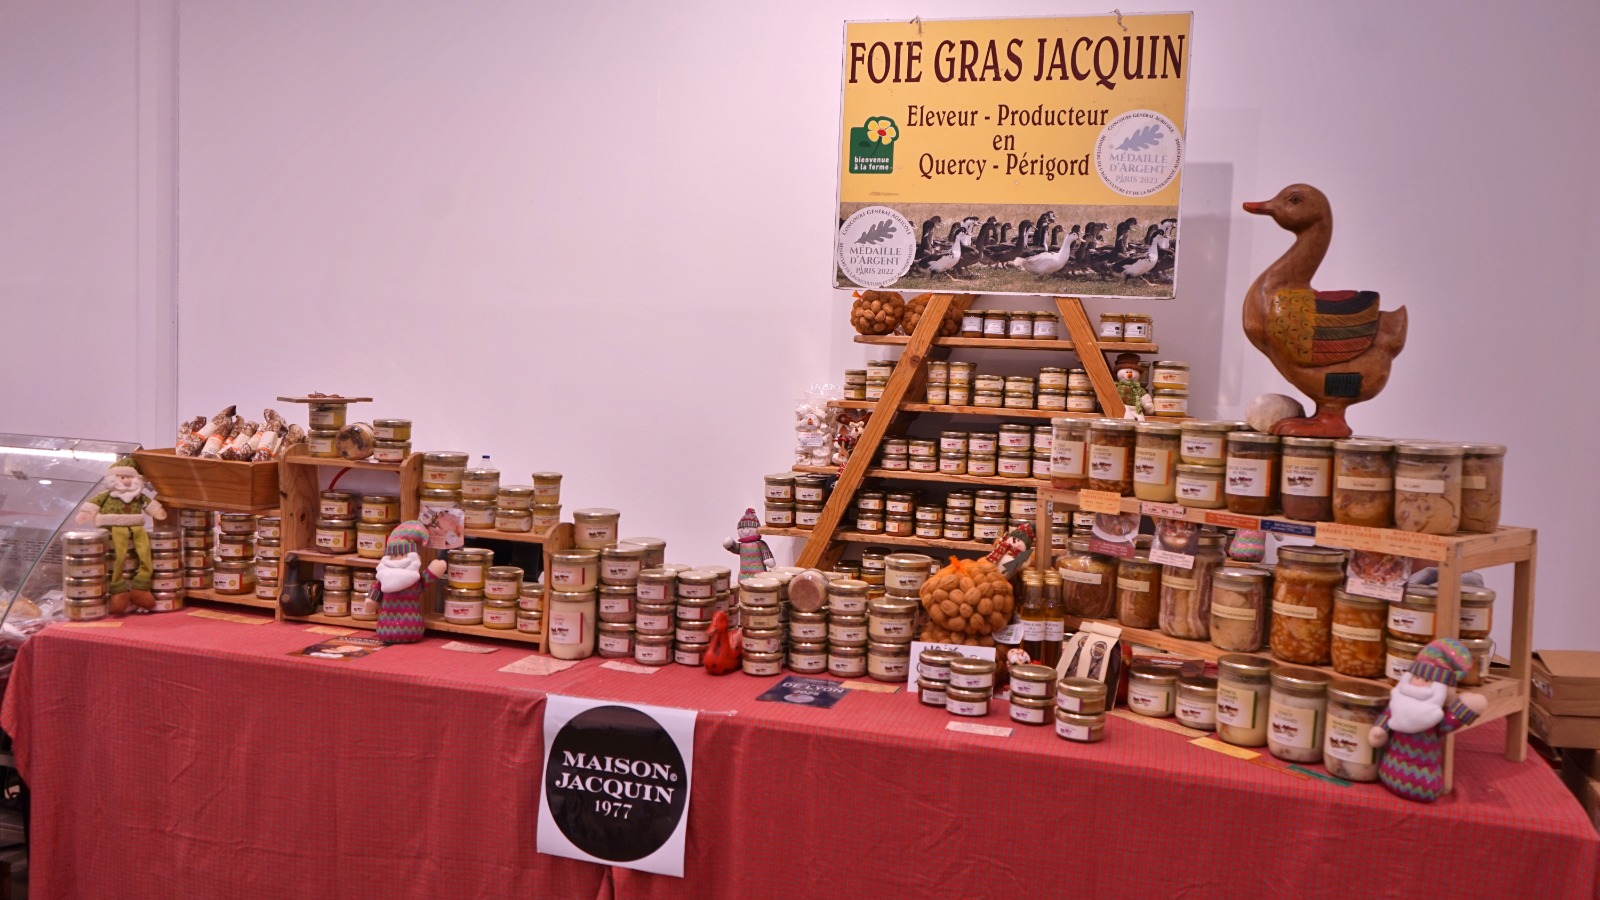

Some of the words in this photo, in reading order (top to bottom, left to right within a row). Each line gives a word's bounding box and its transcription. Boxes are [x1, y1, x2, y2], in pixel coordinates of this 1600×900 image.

[849, 41, 922, 83] FOIE
[934, 38, 1024, 83] GRAS
[1034, 34, 1186, 90] JACQUIN
[907, 105, 978, 127] Eleveur
[997, 104, 1109, 126] Producteur
[993, 133, 1015, 151] en
[1109, 151, 1168, 164] MÉDAILLE
[919, 153, 987, 181] Quercy
[1005, 152, 1091, 181] Périgord
[1109, 162, 1167, 174] D'ARGENT
[1116, 173, 1137, 183] PARIS
[849, 245, 902, 256] MÉDAILLE
[850, 255, 900, 265] D'ARGENT
[856, 265, 875, 275] PARIS
[805, 684, 845, 693] LYON
[555, 772, 674, 804] JACQUIN
[594, 800, 633, 819] 1977
